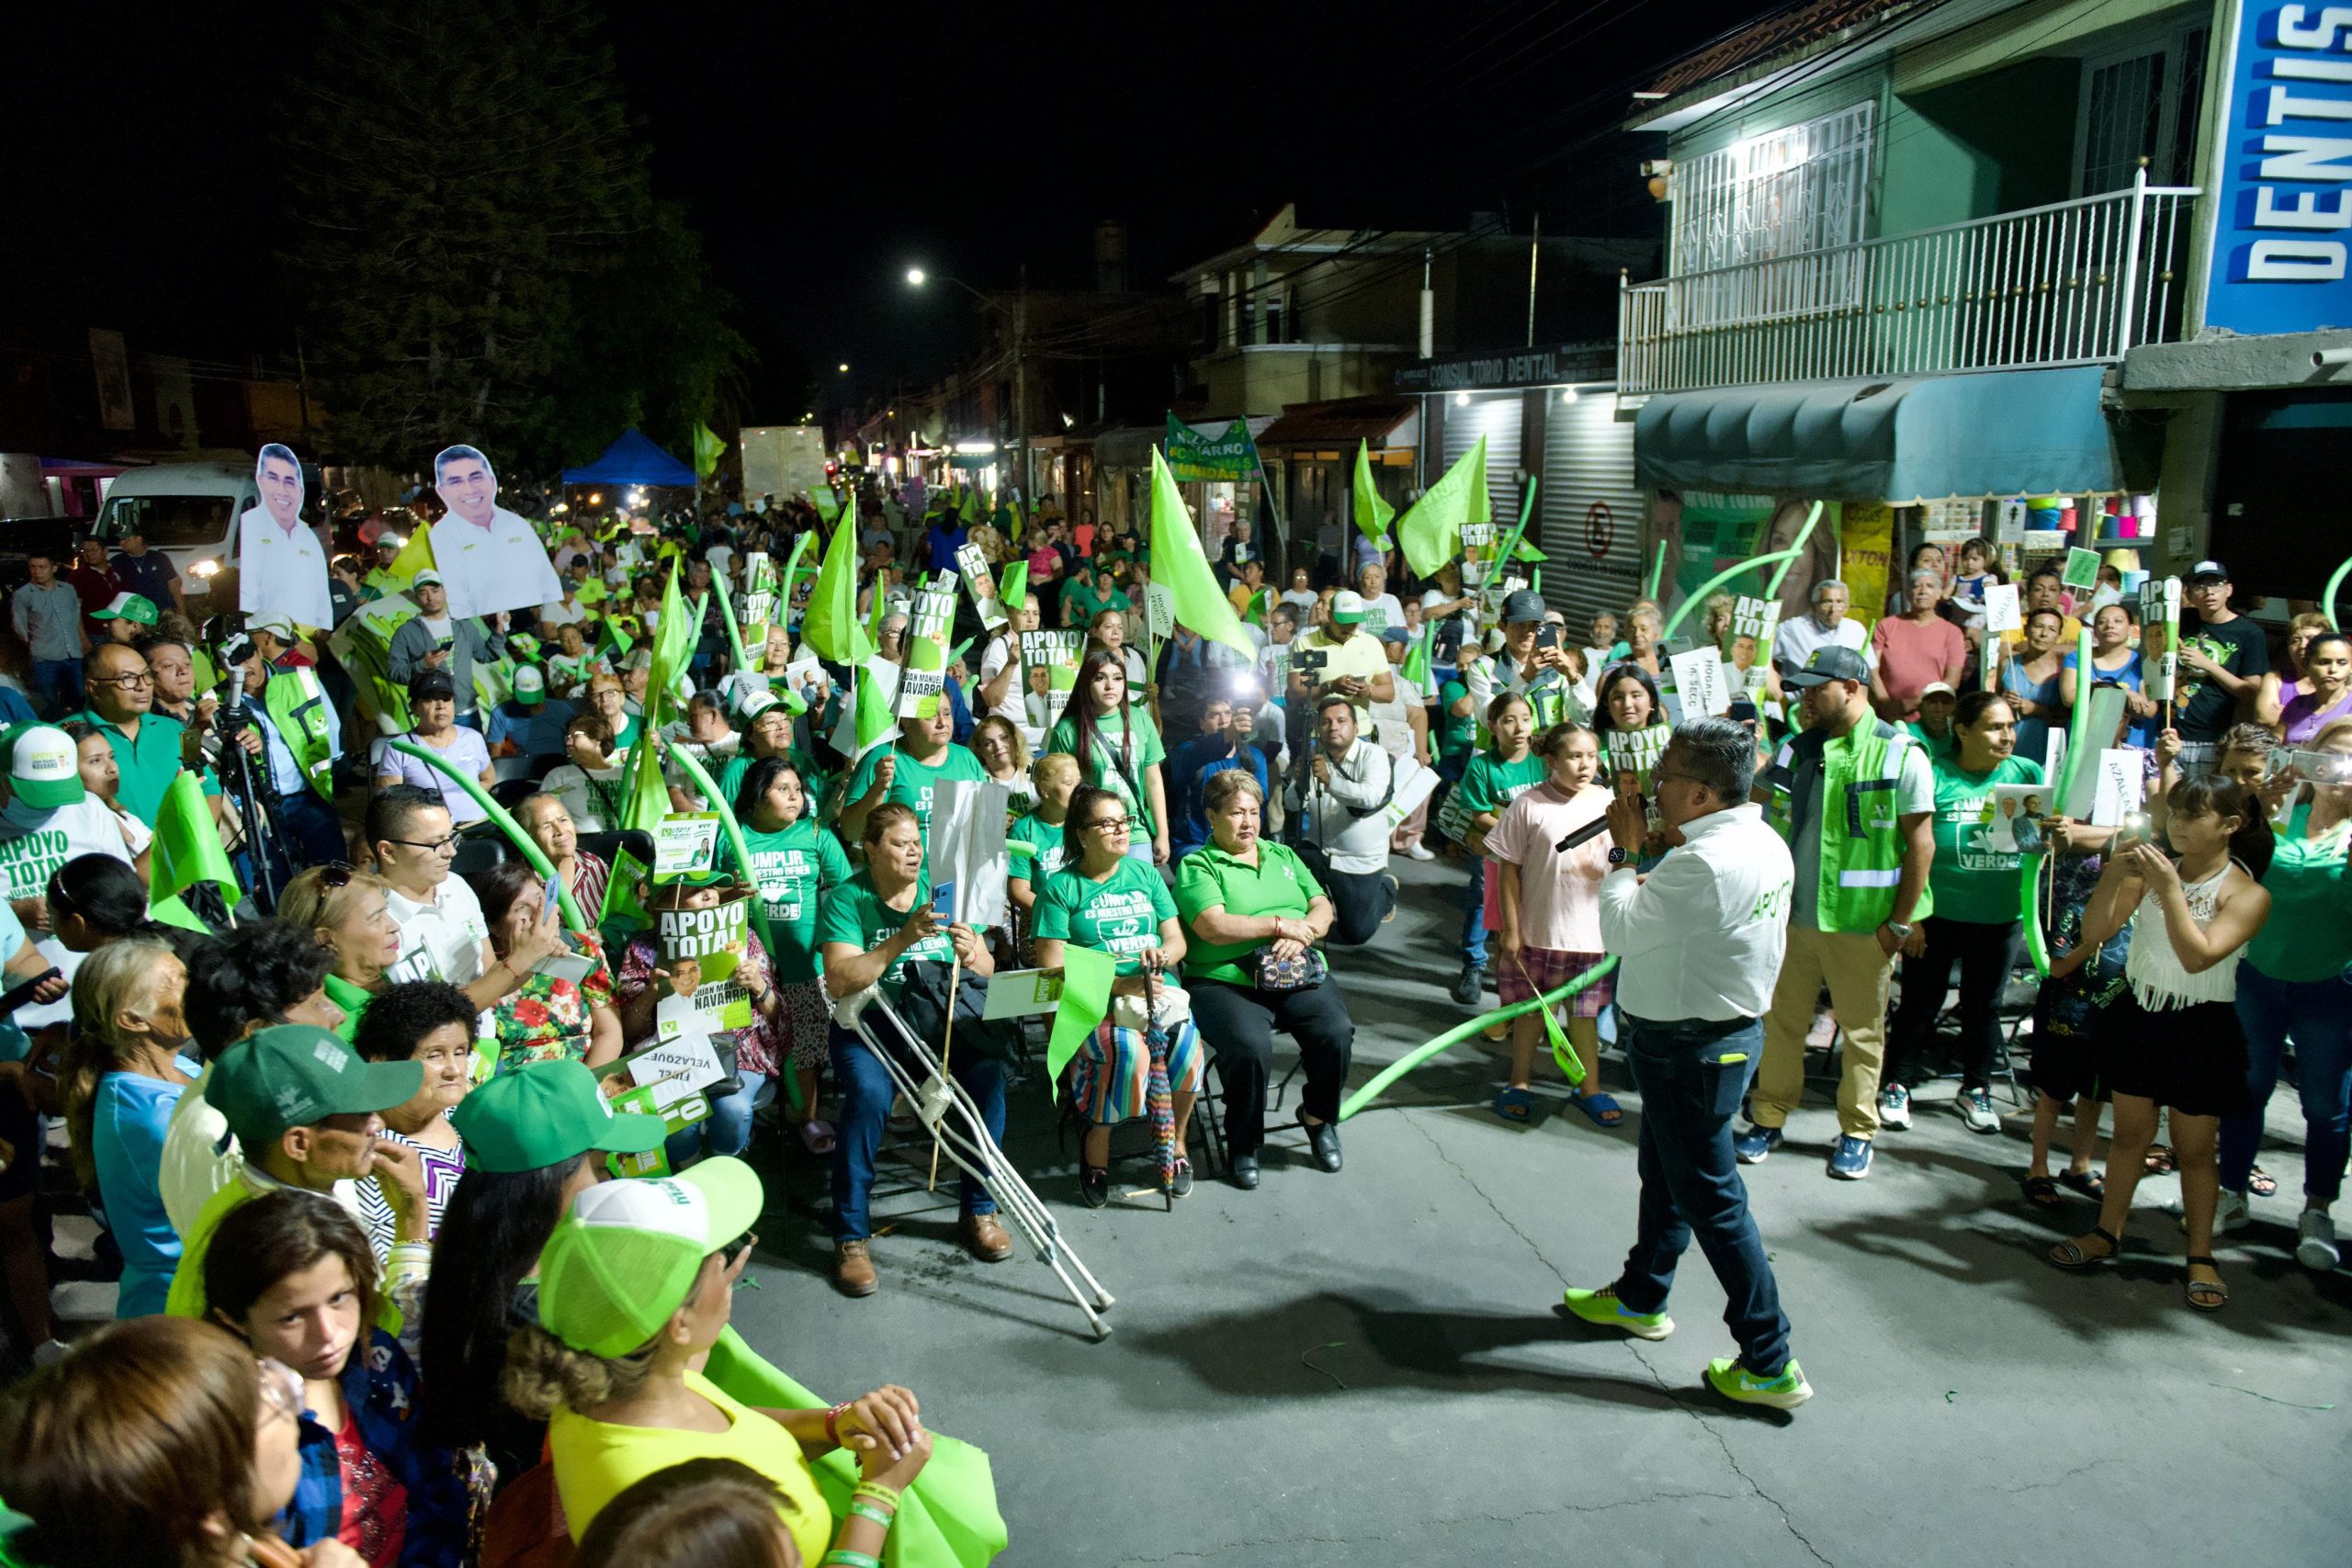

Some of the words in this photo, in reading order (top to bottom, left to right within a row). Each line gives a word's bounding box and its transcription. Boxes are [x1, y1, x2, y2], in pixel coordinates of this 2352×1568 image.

[1430, 358, 1503, 387] CONSULTORIO
[1508, 353, 1559, 382] DENTAL
[910, 590, 955, 618] OYO
[1022, 631, 1079, 649] APOYO
[899, 680, 941, 697] NAVARRO
[919, 674, 942, 685] MANUEL
[1688, 681, 1699, 707] SECC
[1609, 725, 1670, 751] APOYO
[0, 829, 69, 865] APOYO
[785, 864, 810, 876] DEBER
[1091, 891, 1147, 909] CUMPLIR
[661, 901, 744, 936] APOYO
[1085, 909, 1096, 919] ES
[1097, 906, 1134, 918] NUESTRO
[1109, 933, 1157, 953] VERDE
[695, 986, 715, 998] JUAN
[695, 988, 748, 1010] NAVARRO
[644, 1053, 710, 1069] VELAZQUE
